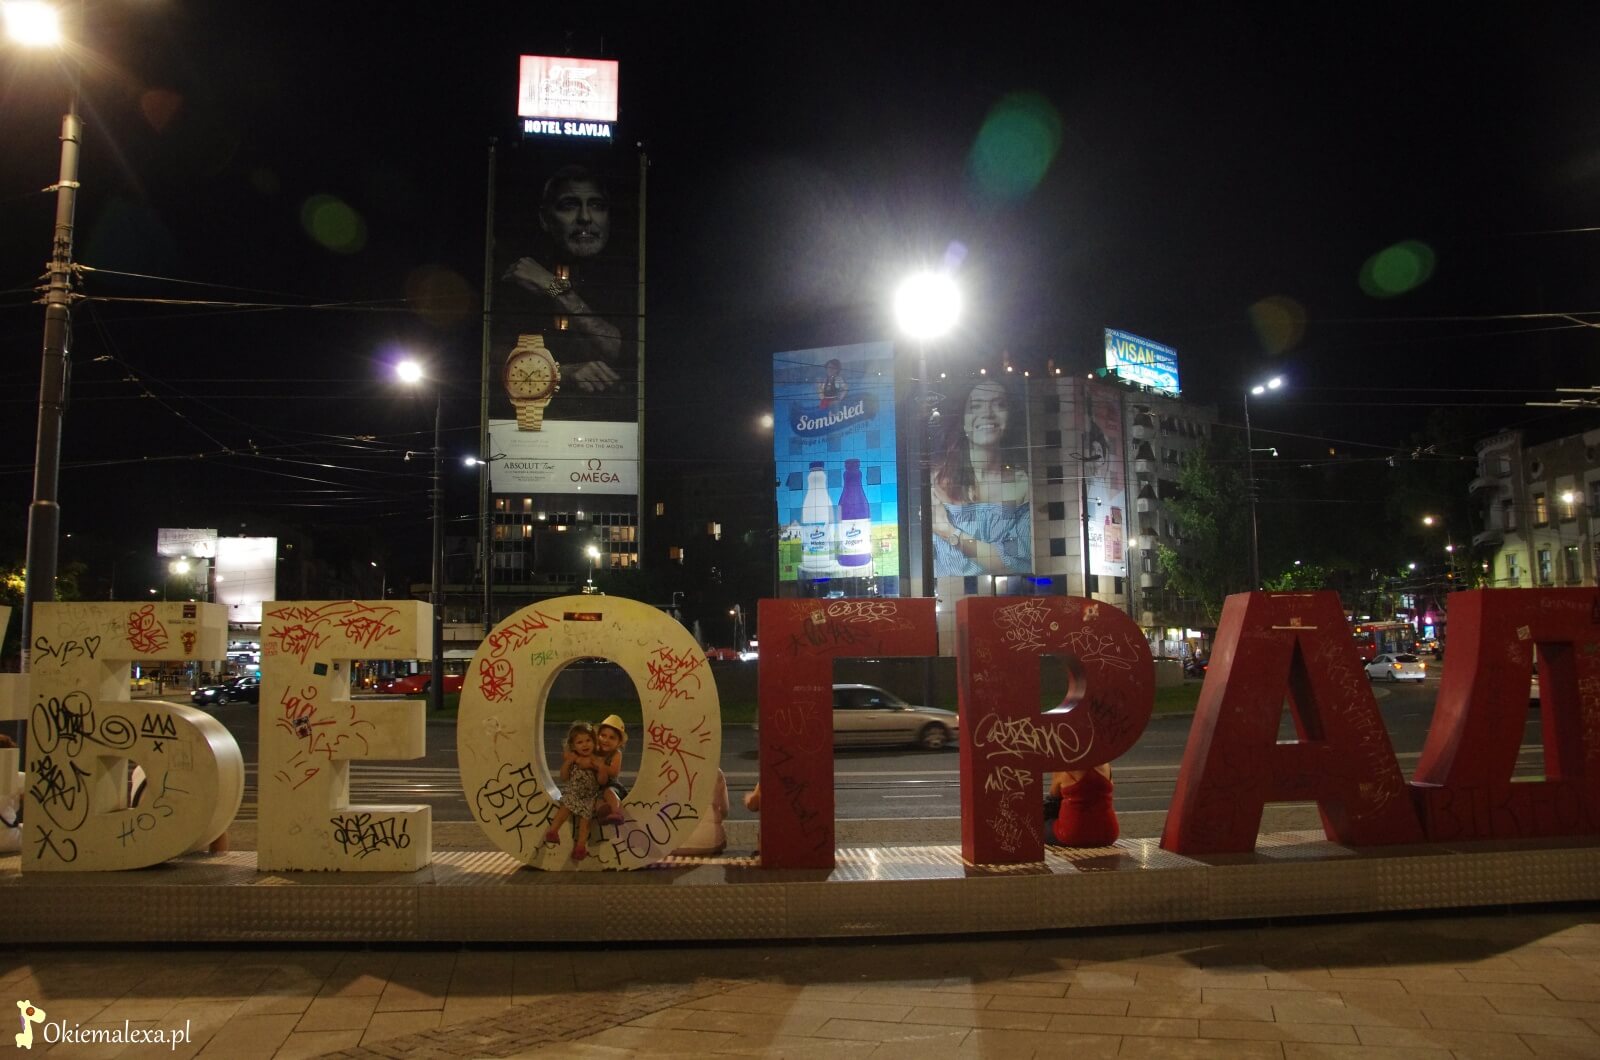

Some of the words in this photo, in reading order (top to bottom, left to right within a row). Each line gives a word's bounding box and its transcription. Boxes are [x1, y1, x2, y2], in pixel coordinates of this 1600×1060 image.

[524, 119, 562, 135] HOTEL
[563, 121, 611, 138] SLAVIJA
[1116, 338, 1156, 368] VISAN
[796, 400, 865, 431] Somboled
[503, 462, 539, 470] ABSOLUT
[570, 471, 621, 483] OMEGA
[0, 590, 1600, 874] БЕОГРАД
[611, 802, 699, 866] FOUR
